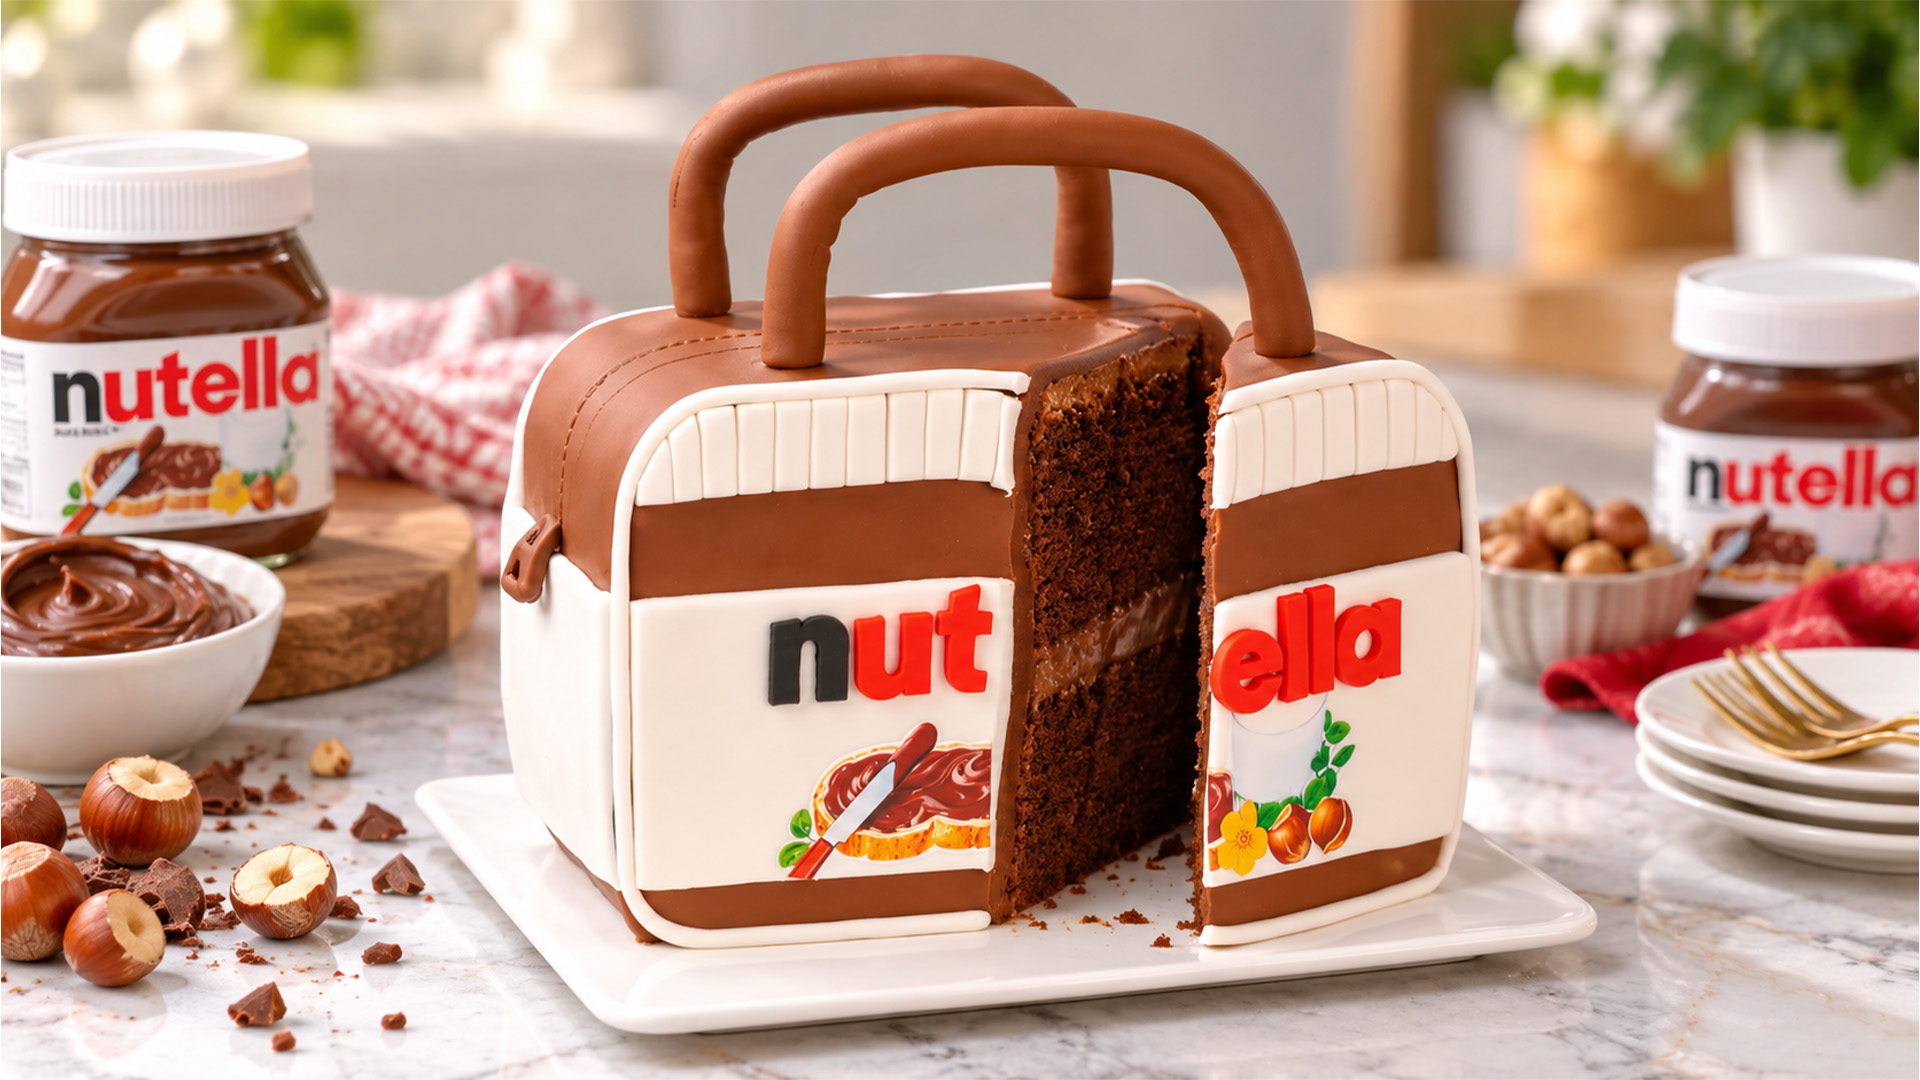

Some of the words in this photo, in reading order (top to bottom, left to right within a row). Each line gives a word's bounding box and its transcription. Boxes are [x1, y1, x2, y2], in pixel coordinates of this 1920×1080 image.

[52, 335, 320, 424] nutella
[1688, 444, 1917, 506] nutella
[768, 583, 993, 707] nut
[1210, 583, 1403, 714] ella
